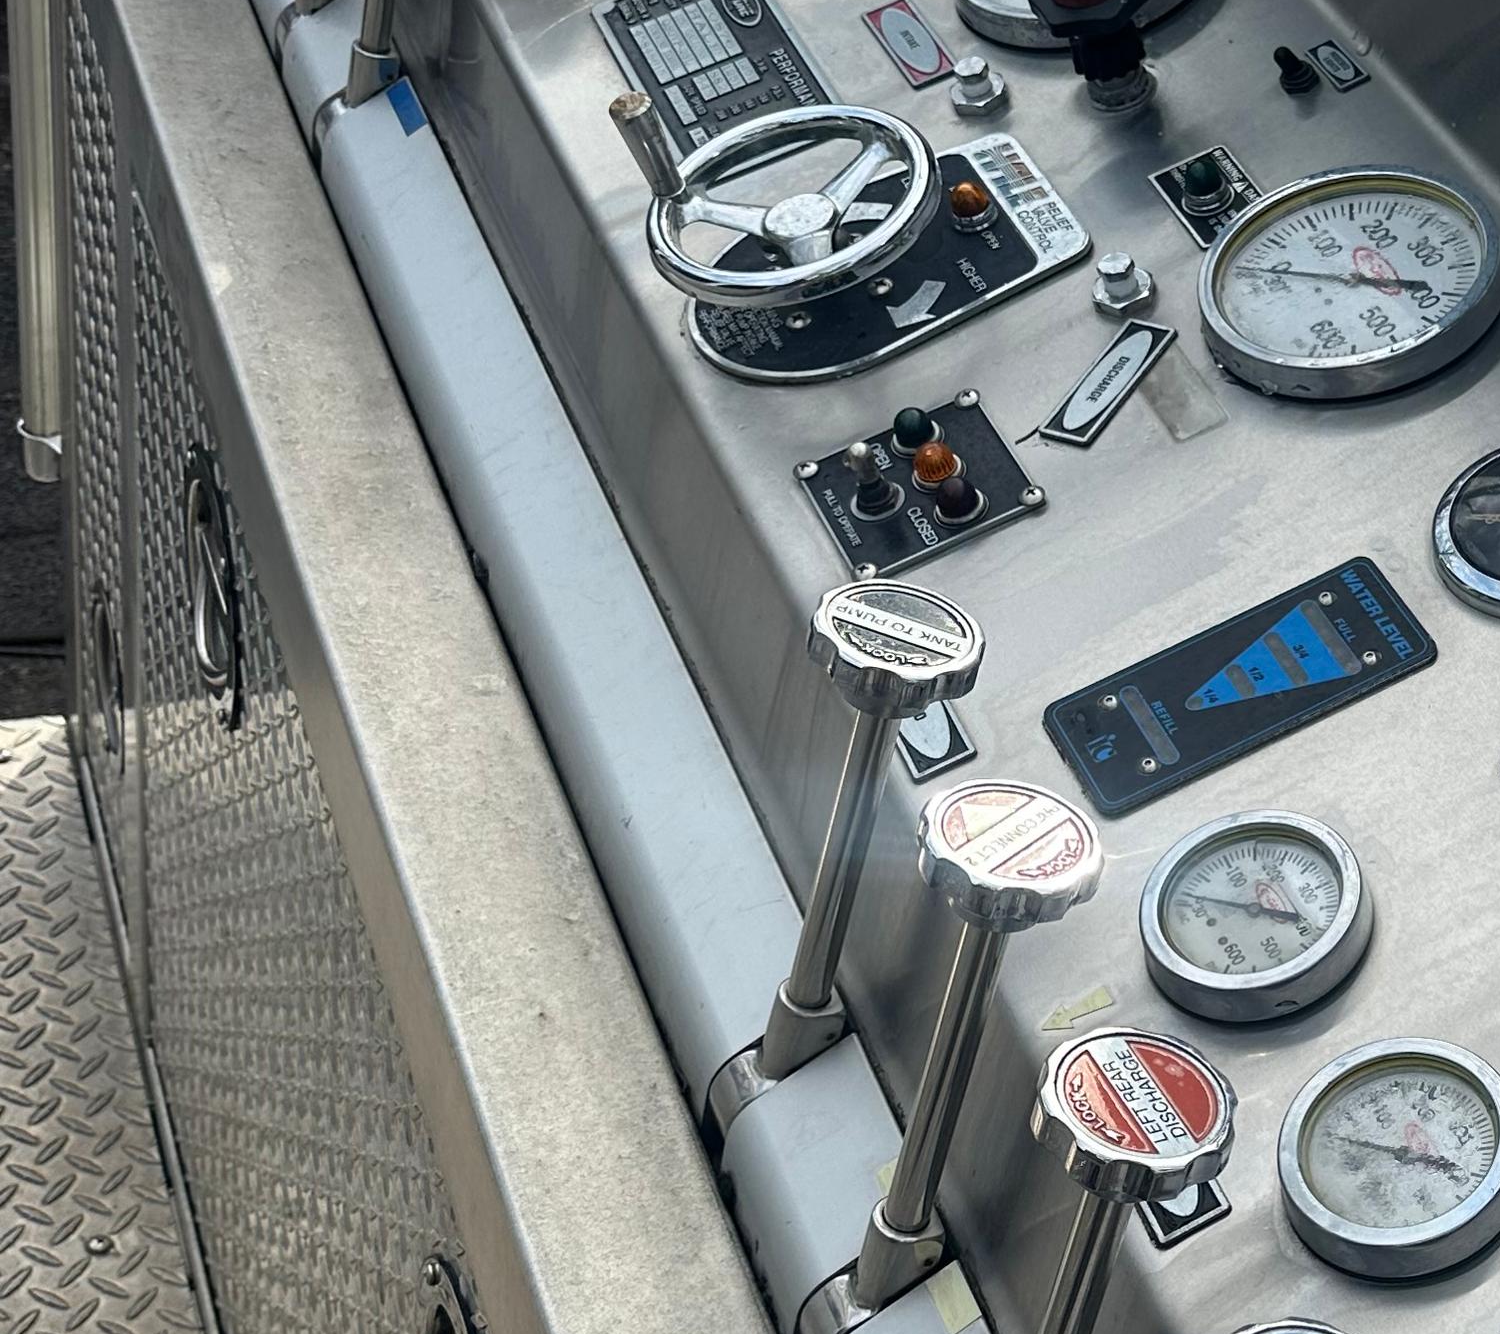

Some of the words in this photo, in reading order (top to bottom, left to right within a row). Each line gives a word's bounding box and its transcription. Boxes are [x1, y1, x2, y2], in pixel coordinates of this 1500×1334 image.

[769, 47, 820, 106] PERFORMAN
[1211, 148, 1243, 182] WARNING
[1017, 209, 1054, 254] CONTROL
[1031, 207, 1057, 236] VALVE
[1047, 201, 1074, 232] RELIEF
[980, 230, 1001, 250] OPEN
[1308, 229, 1343, 258] 100
[1361, 219, 1399, 250] 200
[1408, 236, 1443, 268] 300
[957, 257, 987, 293] HIGHER
[1409, 281, 1440, 309] 00
[1311, 319, 1347, 350] 600
[1360, 305, 1396, 338] 500
[1085, 356, 1130, 403] DISCHARGE
[870, 442, 893, 471] OPEN
[823, 488, 836, 507] PULL
[833, 504, 843, 517] TO
[840, 516, 862, 547] OPERATE
[907, 507, 938, 547] CLOSED
[836, 605, 889, 627] PUMP
[897, 623, 918, 635] TO
[1340, 568, 1383, 617] WATER
[1375, 616, 1414, 660] LEVEL
[921, 631, 962, 652] TANK
[1334, 618, 1356, 643] FULL
[1293, 643, 1309, 660] 3/4
[1248, 666, 1264, 682] 1/2
[1203, 688, 1220, 705] 1/4
[1151, 700, 1180, 735] REFILL
[963, 854, 977, 869] 2
[1226, 867, 1247, 888] 100
[1299, 882, 1318, 904] 300
[1224, 943, 1246, 965] 600
[1260, 936, 1281, 959] 500
[1103, 1060, 1141, 1102] REAR
[1115, 1049, 1187, 1139] DISCHARGE
[1070, 1091, 1105, 1131] LOCK
[1132, 1107, 1169, 1144] LEFT
